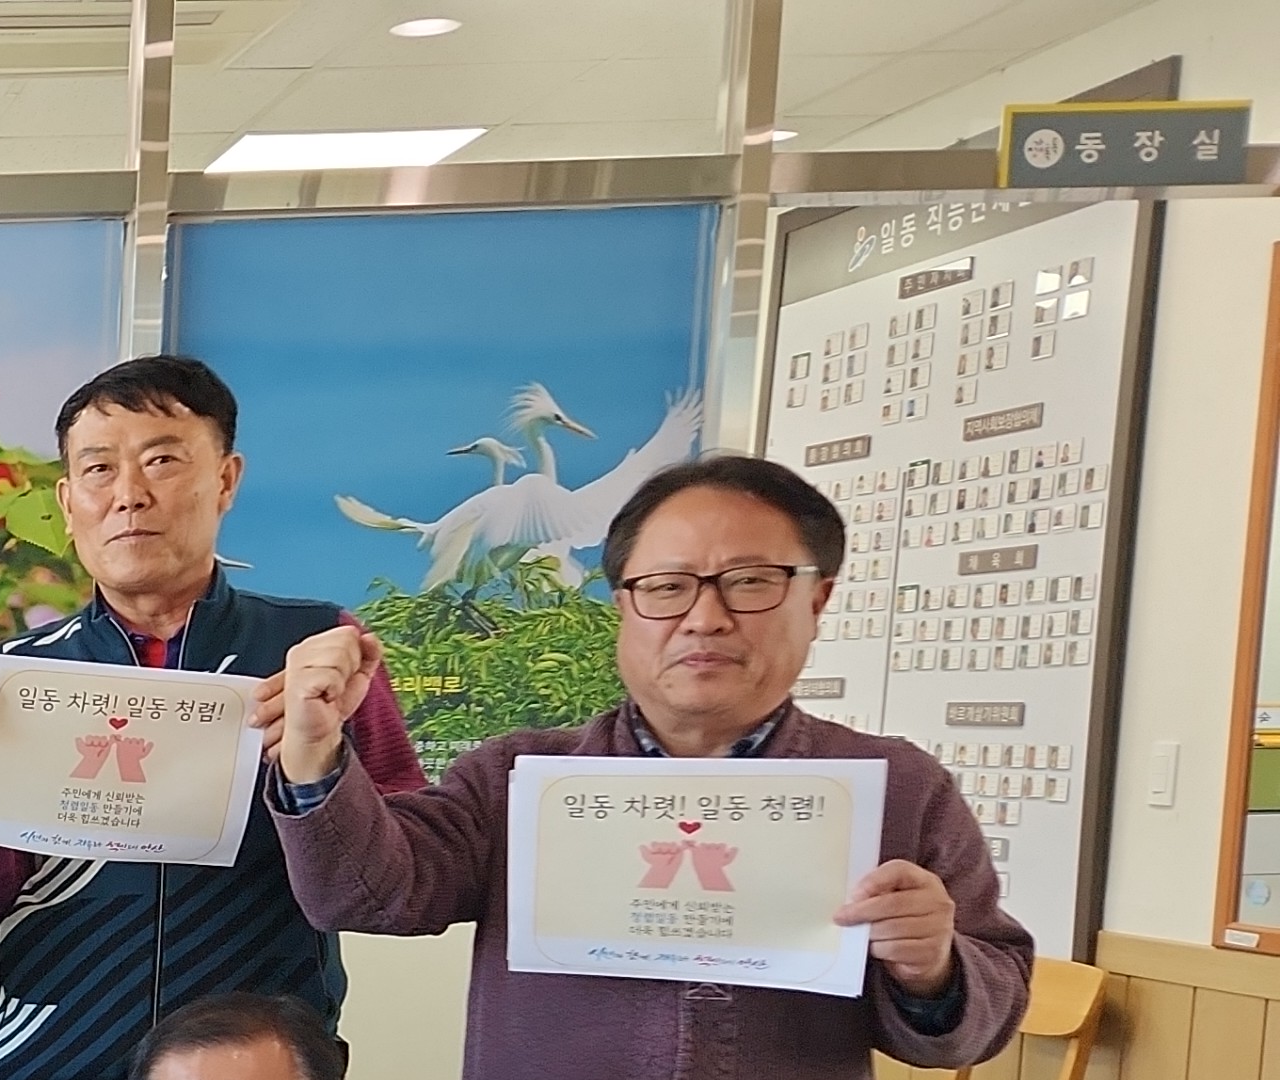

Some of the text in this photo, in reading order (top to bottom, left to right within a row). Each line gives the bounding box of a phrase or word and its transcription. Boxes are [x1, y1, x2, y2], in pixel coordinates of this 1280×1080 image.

[1075, 129, 1220, 163] 동장실
[881, 213, 916, 254] 일동
[19, 687, 225, 722] 일동 차렷! 일동 청렴!
[60, 800, 143, 816] 청렴일동 만들기에
[61, 788, 145, 803] 주민에게 신뢰받는
[564, 795, 825, 821] 일동 차렷! 일동 청렴!
[58, 813, 140, 828] 더욱 힘쓰겠습니다
